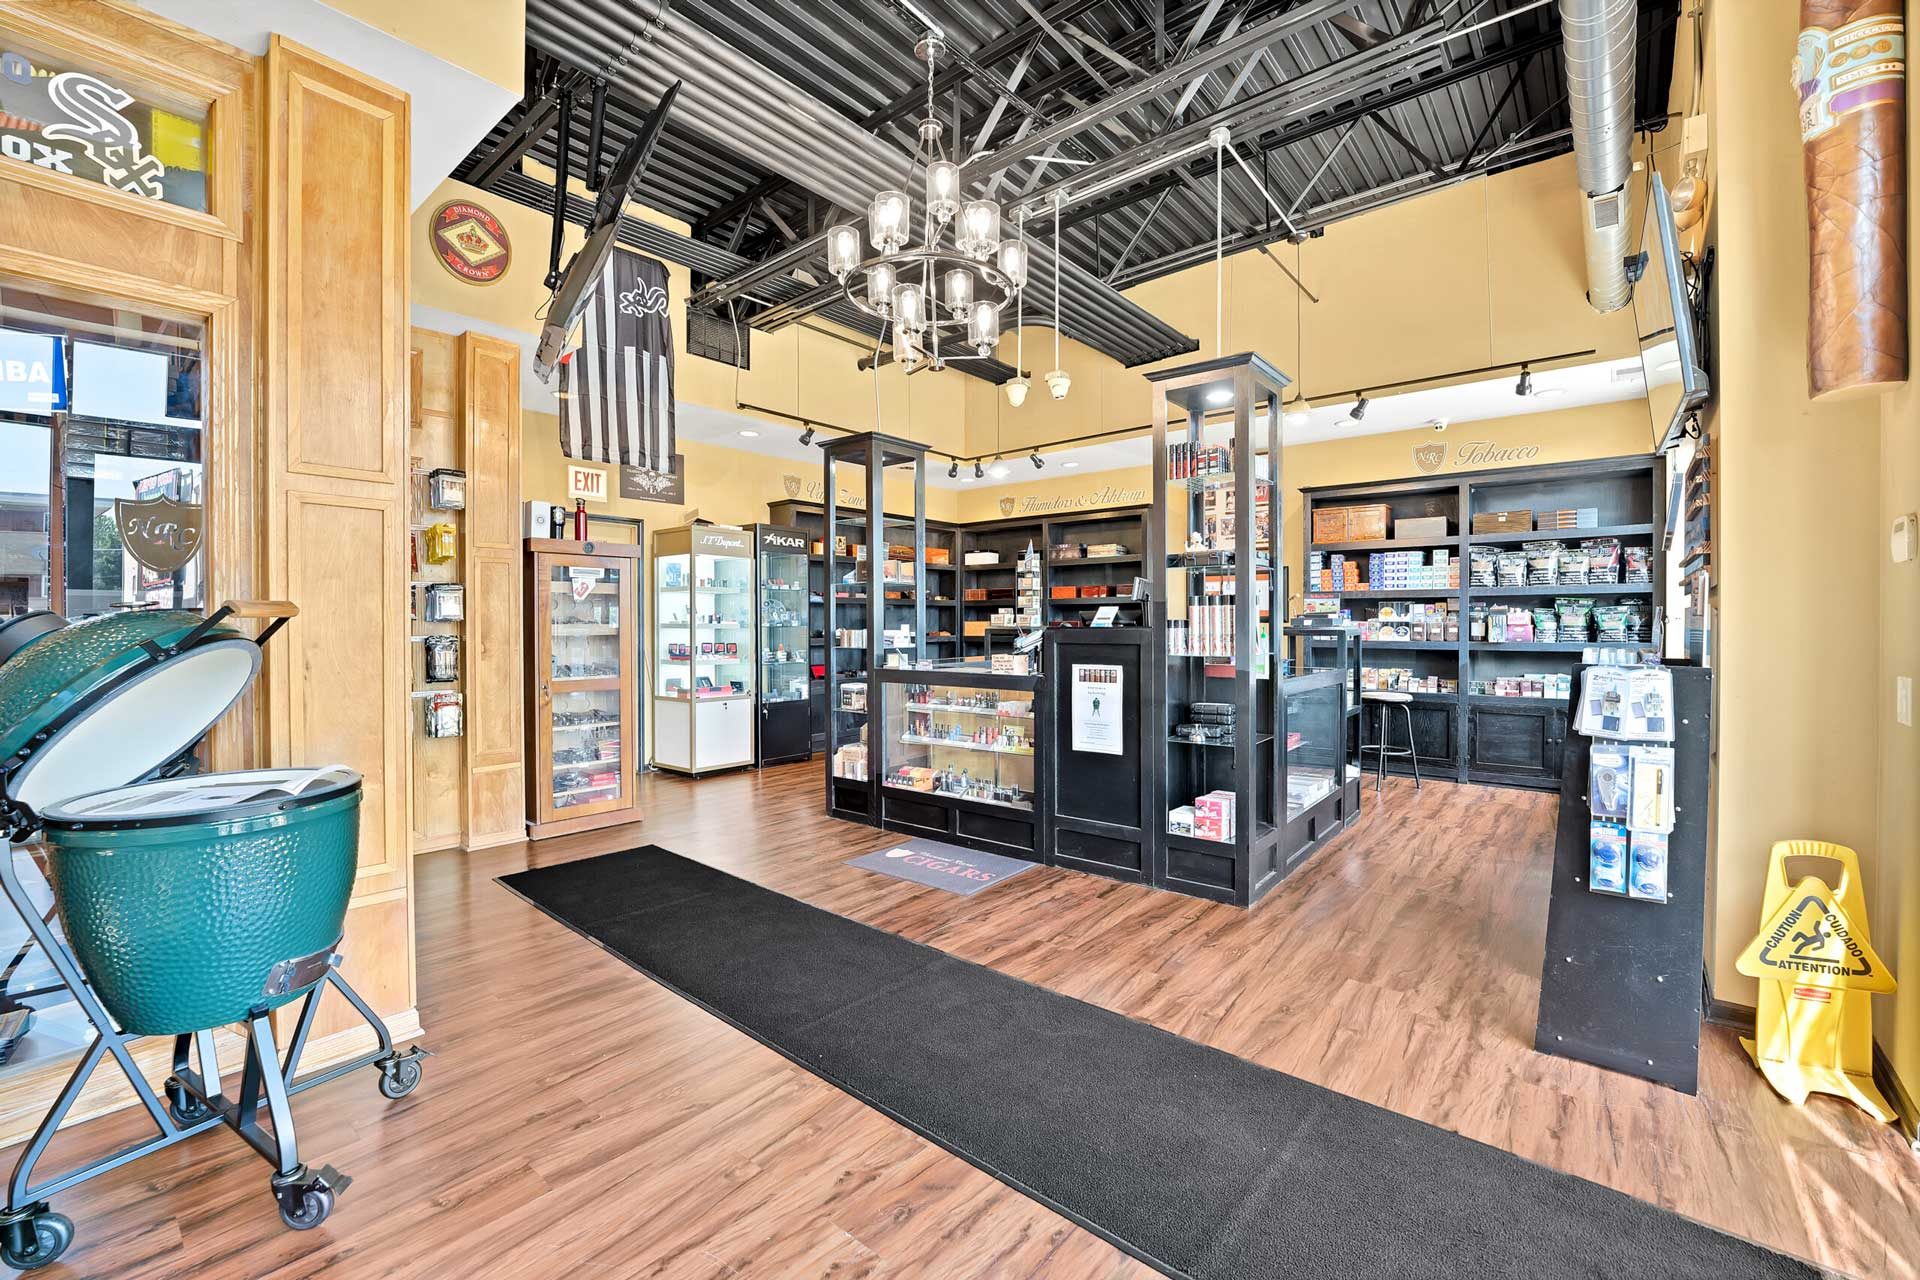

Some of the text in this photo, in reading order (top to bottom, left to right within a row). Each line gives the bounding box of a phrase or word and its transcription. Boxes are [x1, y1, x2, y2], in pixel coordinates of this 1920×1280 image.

[453, 206, 491, 222] DIAMOND
[457, 263, 490, 277] CROWN
[1454, 440, 1540, 466] Tobacco
[574, 470, 602, 494] EXIT
[1019, 485, 1146, 513] Humidors & Ashtrays
[903, 855, 996, 882] CIGARS
[1766, 909, 1802, 949] CAUTION
[1825, 913, 1863, 958] CUIDADO
[1778, 959, 1851, 977] ATTENTION
